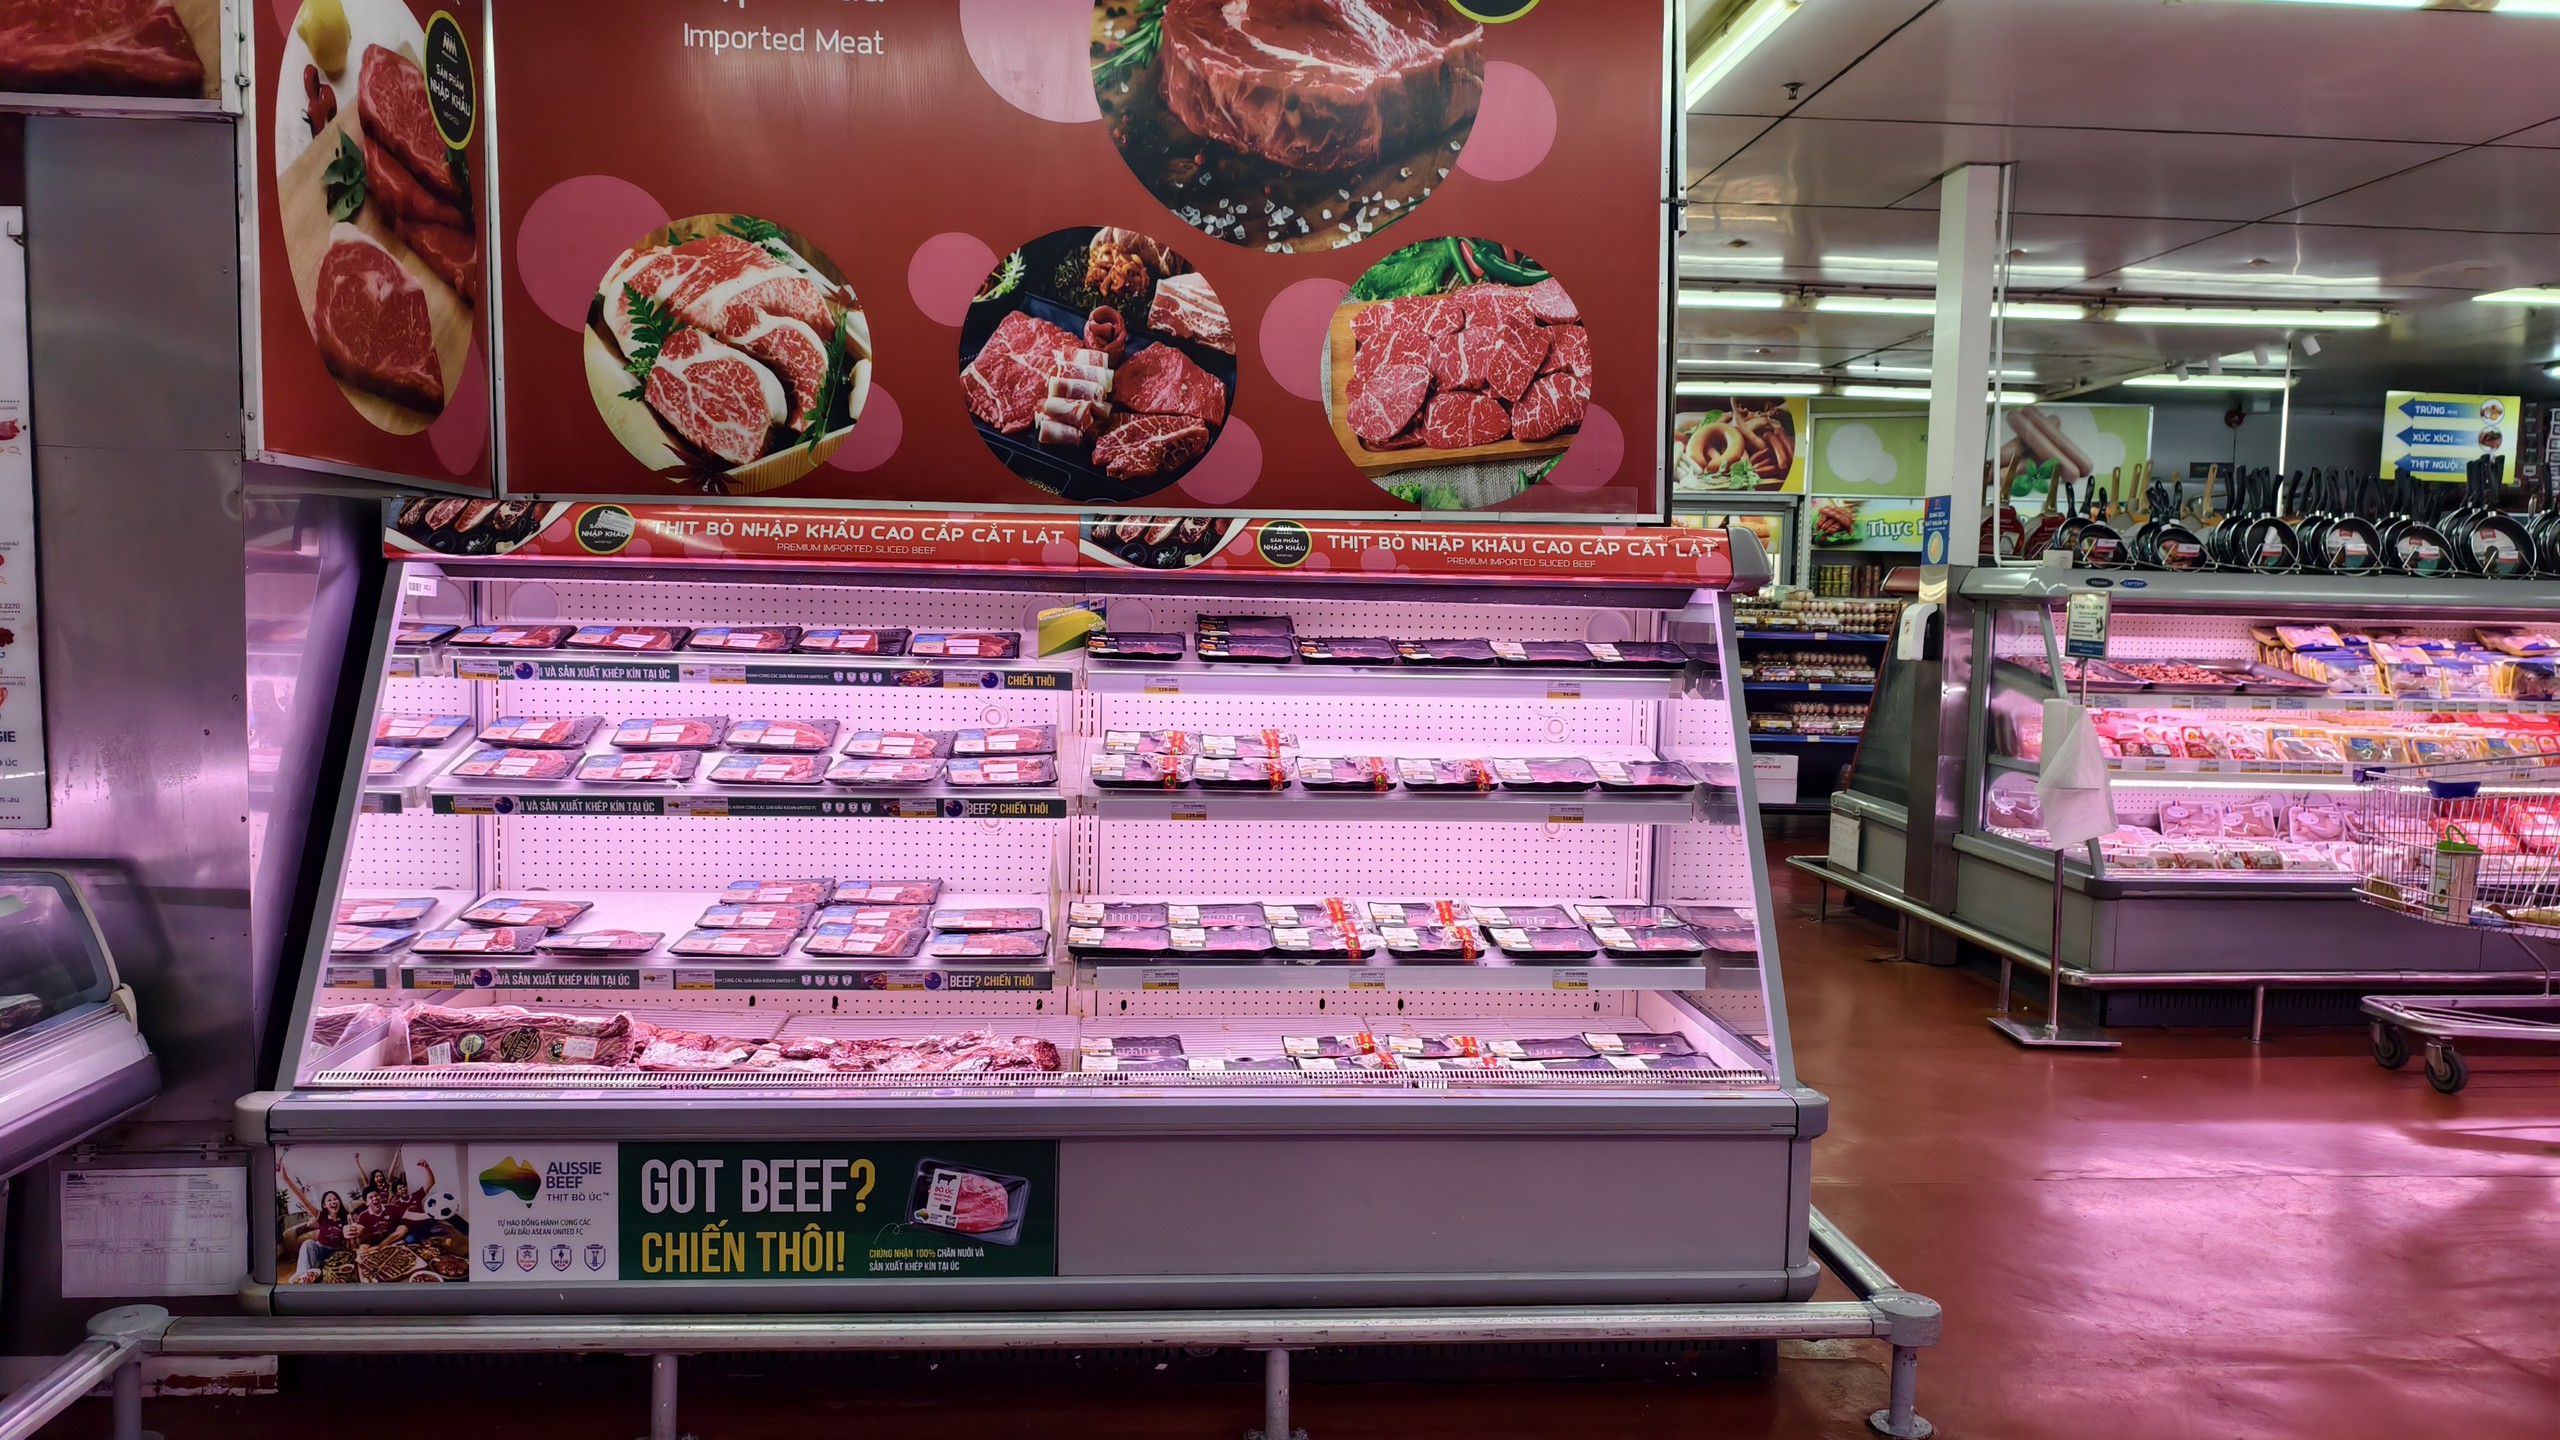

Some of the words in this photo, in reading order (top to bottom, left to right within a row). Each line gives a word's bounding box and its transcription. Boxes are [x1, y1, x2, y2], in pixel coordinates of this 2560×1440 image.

[684, 22, 805, 56] Imported
[815, 28, 885, 55] Meat
[2415, 401, 2446, 415] TRỨNG
[2412, 431, 2431, 443] XÚC
[2433, 431, 2454, 443] XÍCH
[2411, 458, 2430, 472] THỊT
[2432, 459, 2459, 471] NGUỘI
[653, 520, 700, 538] THỊT
[706, 518, 735, 537] BÒ
[741, 519, 799, 541] NHẬP
[806, 518, 865, 540] KHẨU
[871, 525, 914, 541] CAO
[921, 521, 965, 542] CẤP
[971, 522, 1015, 543] CẮT
[1022, 526, 1065, 545] LÁT
[1868, 519, 1913, 540] Thực
[777, 543, 821, 552] PREMIUM
[823, 544, 873, 554] IMPORTED
[875, 544, 909, 554] SLICED
[911, 546, 937, 555] BEEF
[1263, 543, 1284, 553] NHẬP
[1285, 543, 1306, 552] KHẨU
[1327, 535, 1371, 553] THỊT
[1378, 533, 1405, 551] BÒ
[1412, 535, 1465, 555] NHẬP
[1472, 535, 1526, 553] KHẨU
[1532, 540, 1573, 555] CAO
[1580, 538, 1621, 556] CẤP
[1627, 538, 1669, 557] CẮT
[1675, 539, 1715, 558] LÁT
[1447, 557, 1488, 566] PREMIUM
[1490, 558, 1536, 567] IMPORTED
[1538, 559, 1571, 568] SLICED
[1572, 560, 1597, 568] BEEF
[545, 665, 557, 678] VÀ
[558, 665, 576, 678] SẢN
[577, 665, 600, 678] XUẤT
[602, 666, 625, 679] KHÉP
[627, 666, 642, 679] KÍN
[642, 668, 658, 681] TẠI
[659, 666, 671, 679] ÚC
[1007, 672, 1034, 687] CHIẾN
[1035, 675, 1056, 687] THÔI
[526, 800, 537, 812] VÀ
[540, 798, 558, 812] SẢN
[560, 798, 583, 812] XUẤT
[585, 800, 608, 812] KHÉP
[610, 800, 625, 812] KÍN
[627, 802, 642, 814] TẠI
[643, 800, 655, 812] ÚC
[1000, 800, 1027, 814] CHIẾN
[1028, 803, 1049, 814] THÔI
[499, 973, 511, 985] VÀ
[511, 973, 531, 985] SẢN
[533, 972, 557, 986] XUẤT
[559, 973, 584, 986] KHÉP
[584, 973, 600, 986] KÍN
[602, 975, 616, 988] TẠI
[618, 973, 630, 986] ÚC
[950, 975, 981, 988] BEEF?
[984, 973, 1011, 987] CHIẾN
[1013, 975, 1034, 987] THÔI
[546, 1161, 602, 1175] AUSSIE
[546, 1176, 583, 1189] BEEF
[641, 1158, 724, 1213] GOT
[741, 1158, 876, 1213] BEEF?
[546, 1193, 569, 1203] THỊT
[571, 1192, 586, 1201] BÒ
[541, 1218, 559, 1226] HÀNH
[579, 1218, 591, 1226] CÁC
[641, 1219, 745, 1273] CHIẾN
[756, 1222, 845, 1272] THÔI!
[869, 1248, 893, 1259] CHỨNG
[894, 1247, 913, 1260] NHẬN
[915, 1248, 936, 1258] 100%
[937, 1247, 956, 1258] CHĂN
[957, 1247, 974, 1258] NUÔI
[975, 1246, 984, 1257] VÀ
[869, 1261, 883, 1272] SẢN
[884, 1259, 904, 1271] XUẤT
[905, 1261, 923, 1271] KHÉP
[924, 1260, 936, 1271] KÍN
[937, 1261, 949, 1273] TẠI
[950, 1260, 960, 1271] ÚC
